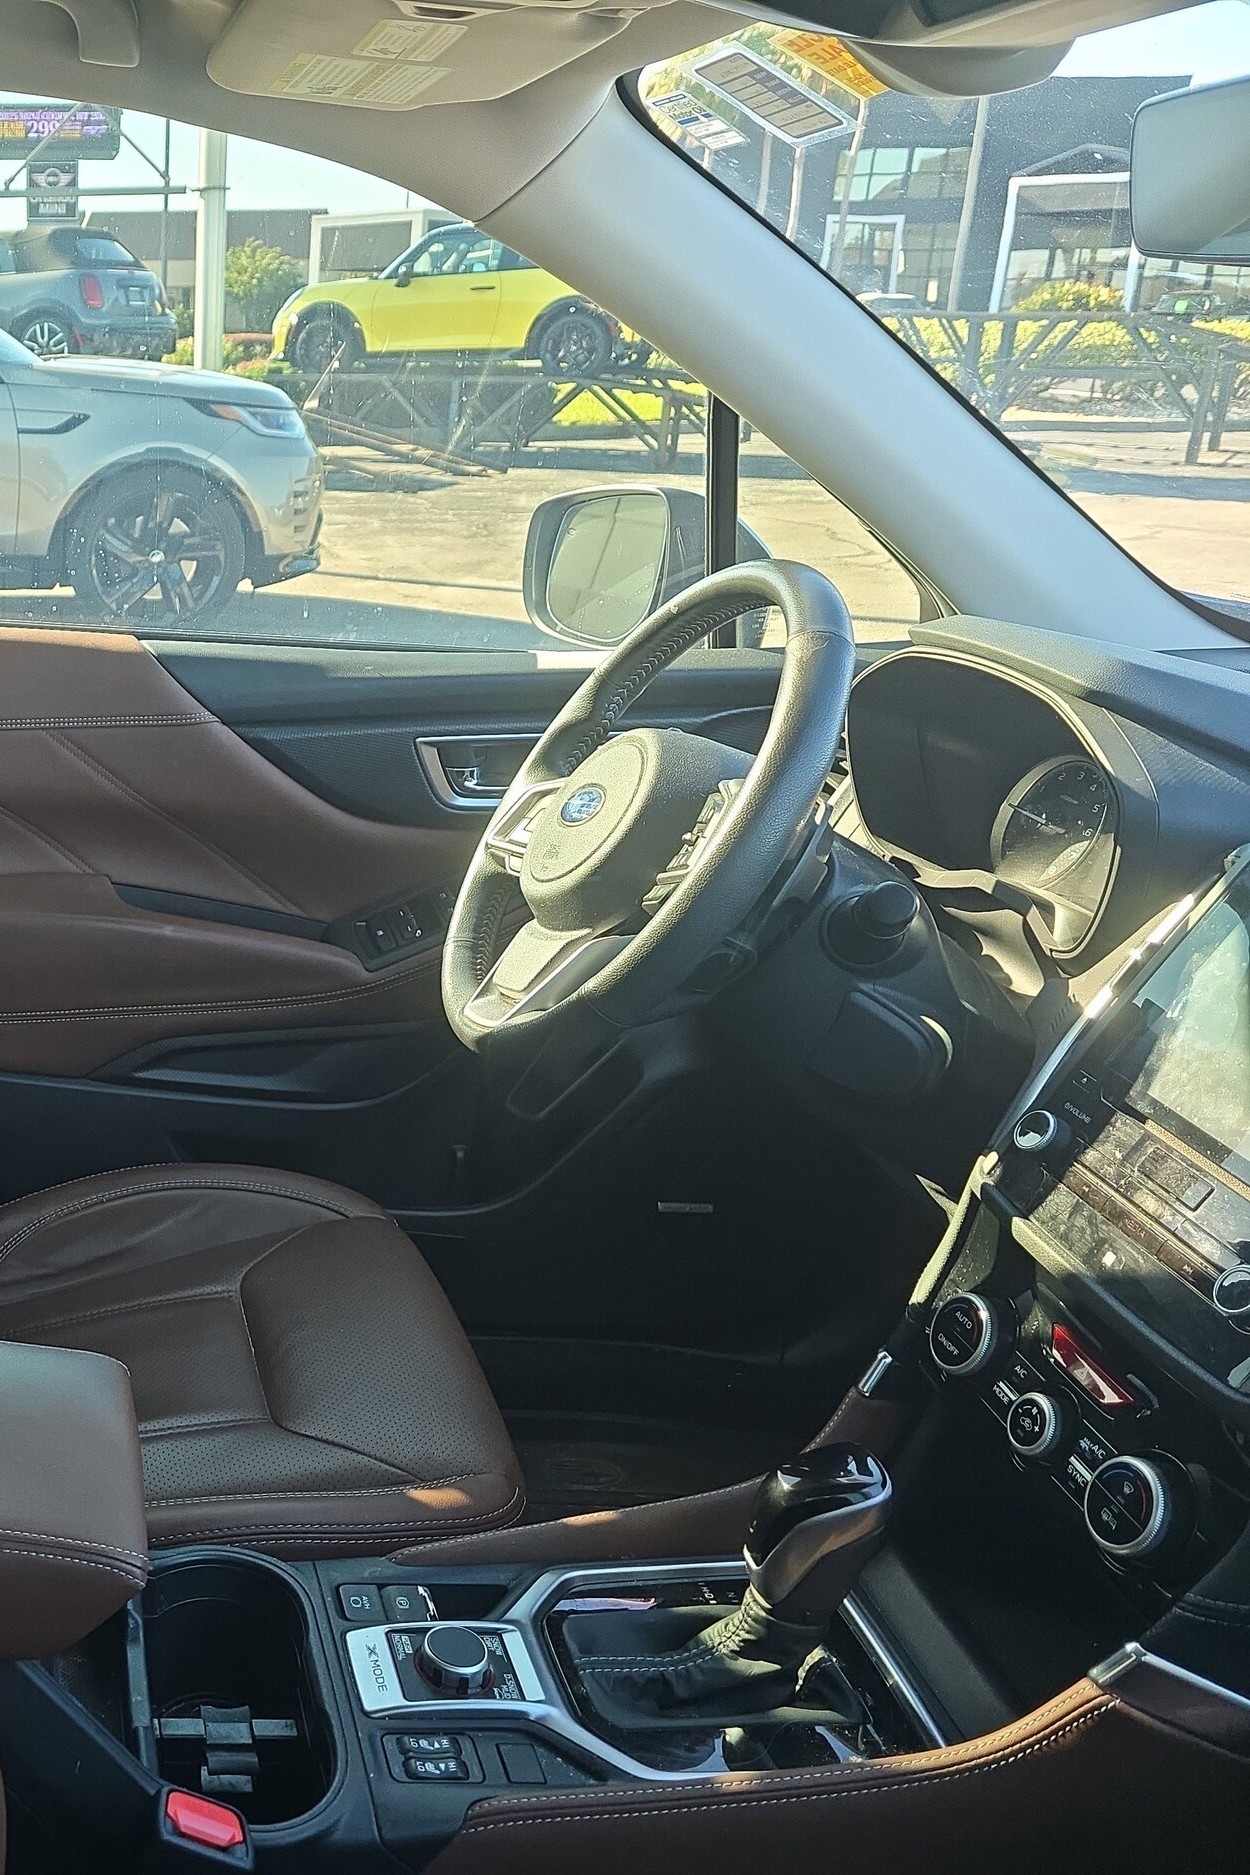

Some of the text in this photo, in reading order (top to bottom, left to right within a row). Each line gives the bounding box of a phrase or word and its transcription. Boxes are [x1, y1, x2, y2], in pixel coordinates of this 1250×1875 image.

[659, 100, 697, 113] Certified
[668, 110, 695, 120] Motor
[955, 1310, 973, 1330] AUTO
[937, 1332, 960, 1357] ON/OFF
[1014, 1364, 1028, 1379] A/C
[992, 1384, 1009, 1405] MODE
[1093, 1444, 1107, 1459] A/C
[1066, 1464, 1088, 1487] SYNC
[361, 1595, 371, 1610] AVH
[393, 1635, 406, 1660] NORMAL
[484, 1637, 494, 1651] DIRT
[491, 1637, 502, 1656] SNOW
[410, 1737, 419, 1748] LO
[441, 1739, 450, 1748] HI
[416, 1761, 425, 1772] LO
[448, 1762, 457, 1772] HI
